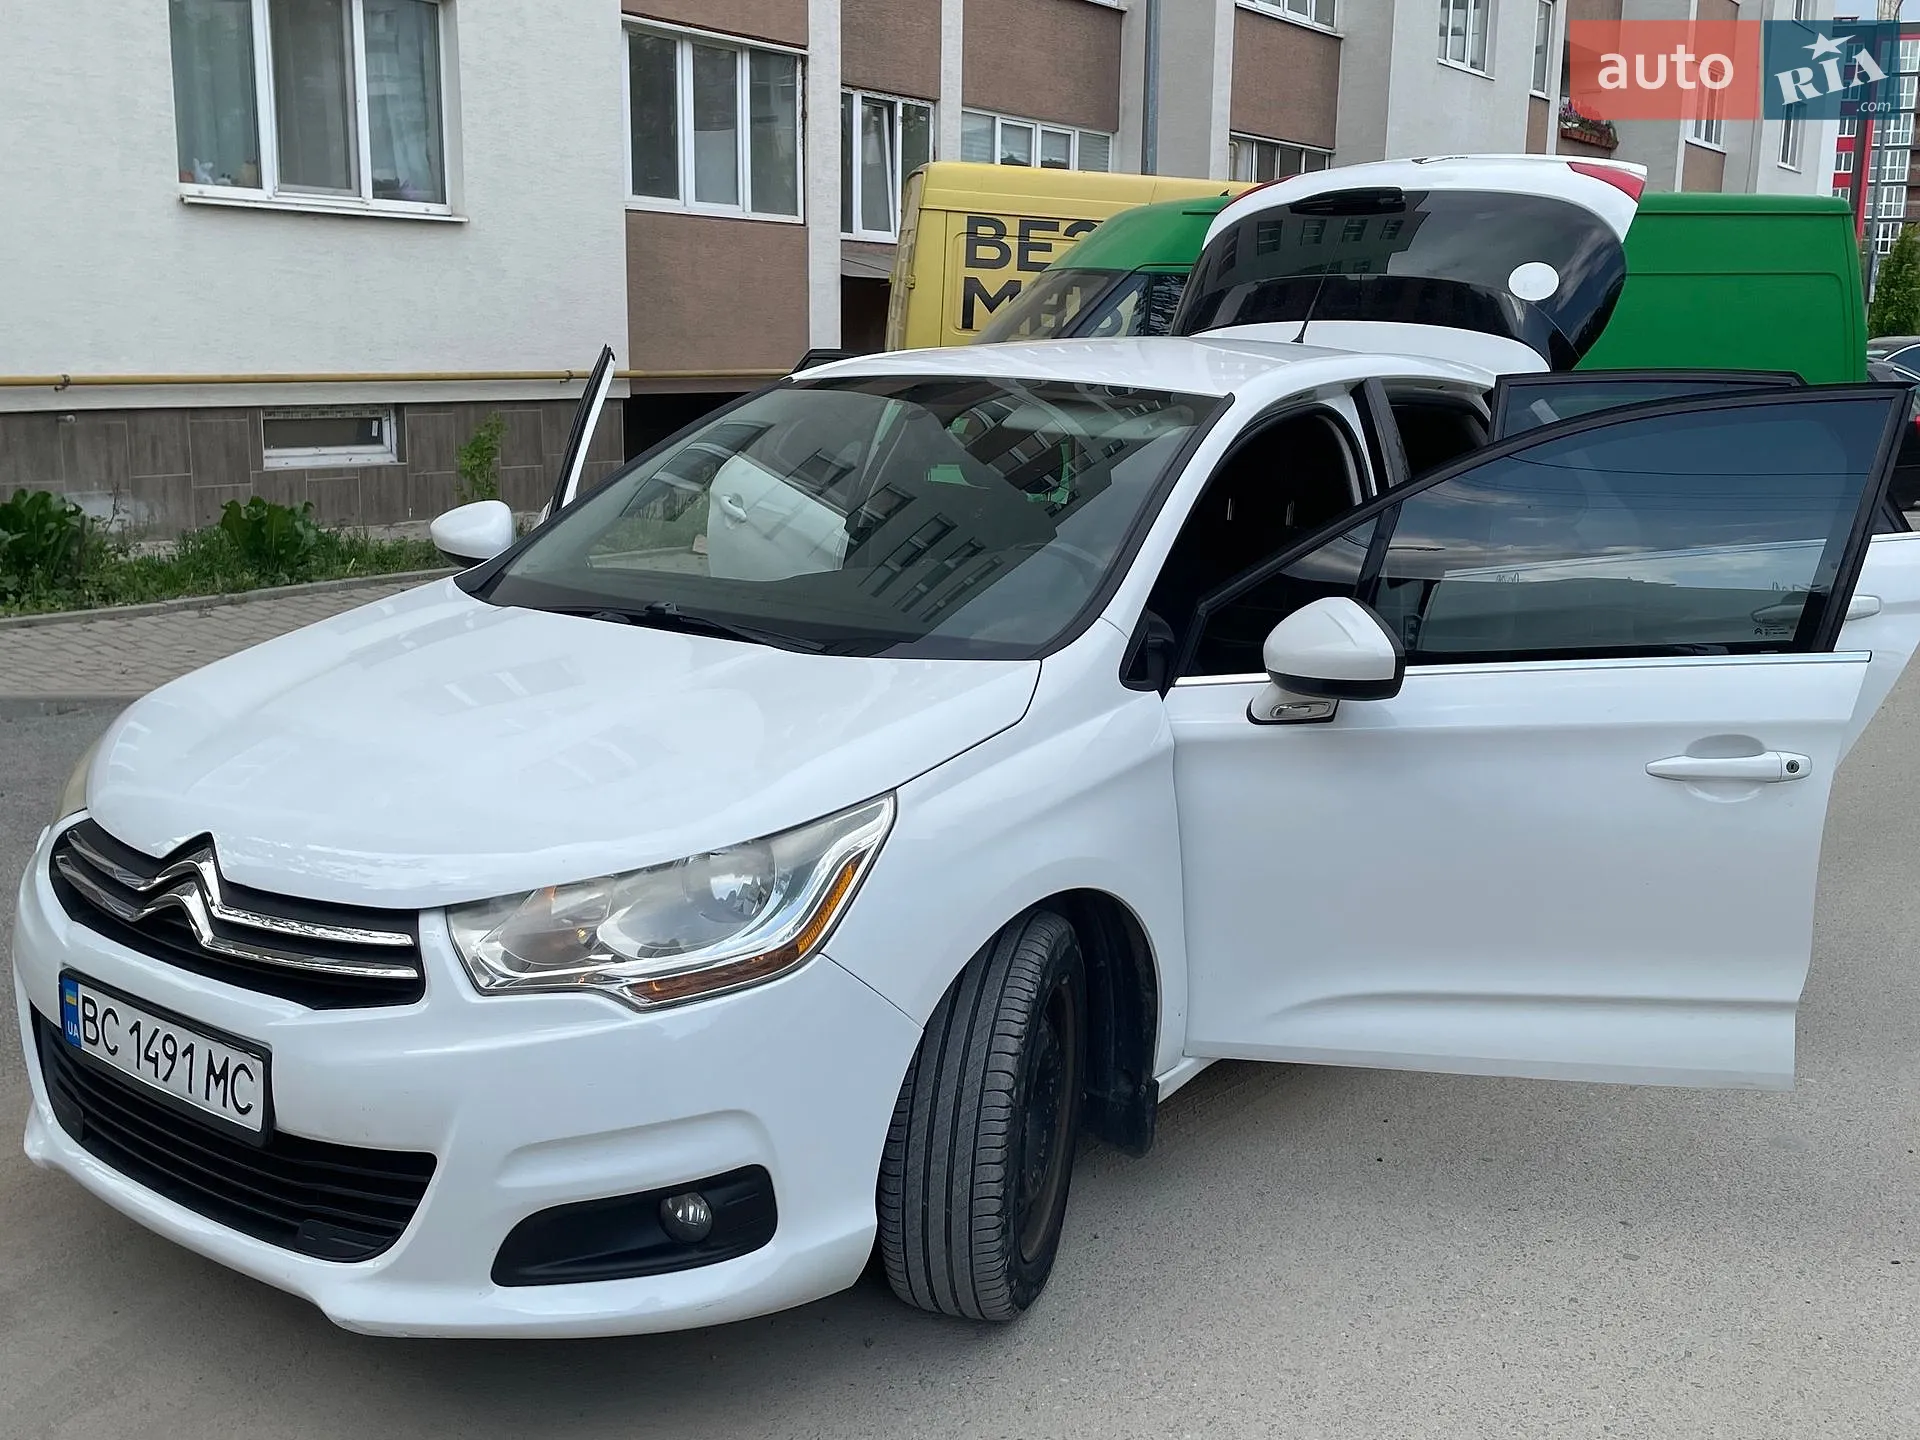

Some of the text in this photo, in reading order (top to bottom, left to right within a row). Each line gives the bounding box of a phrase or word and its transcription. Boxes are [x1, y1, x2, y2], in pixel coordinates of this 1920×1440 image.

[67, 1020, 80, 1040] UA
[82, 993, 255, 1116] BC 1491 MC
